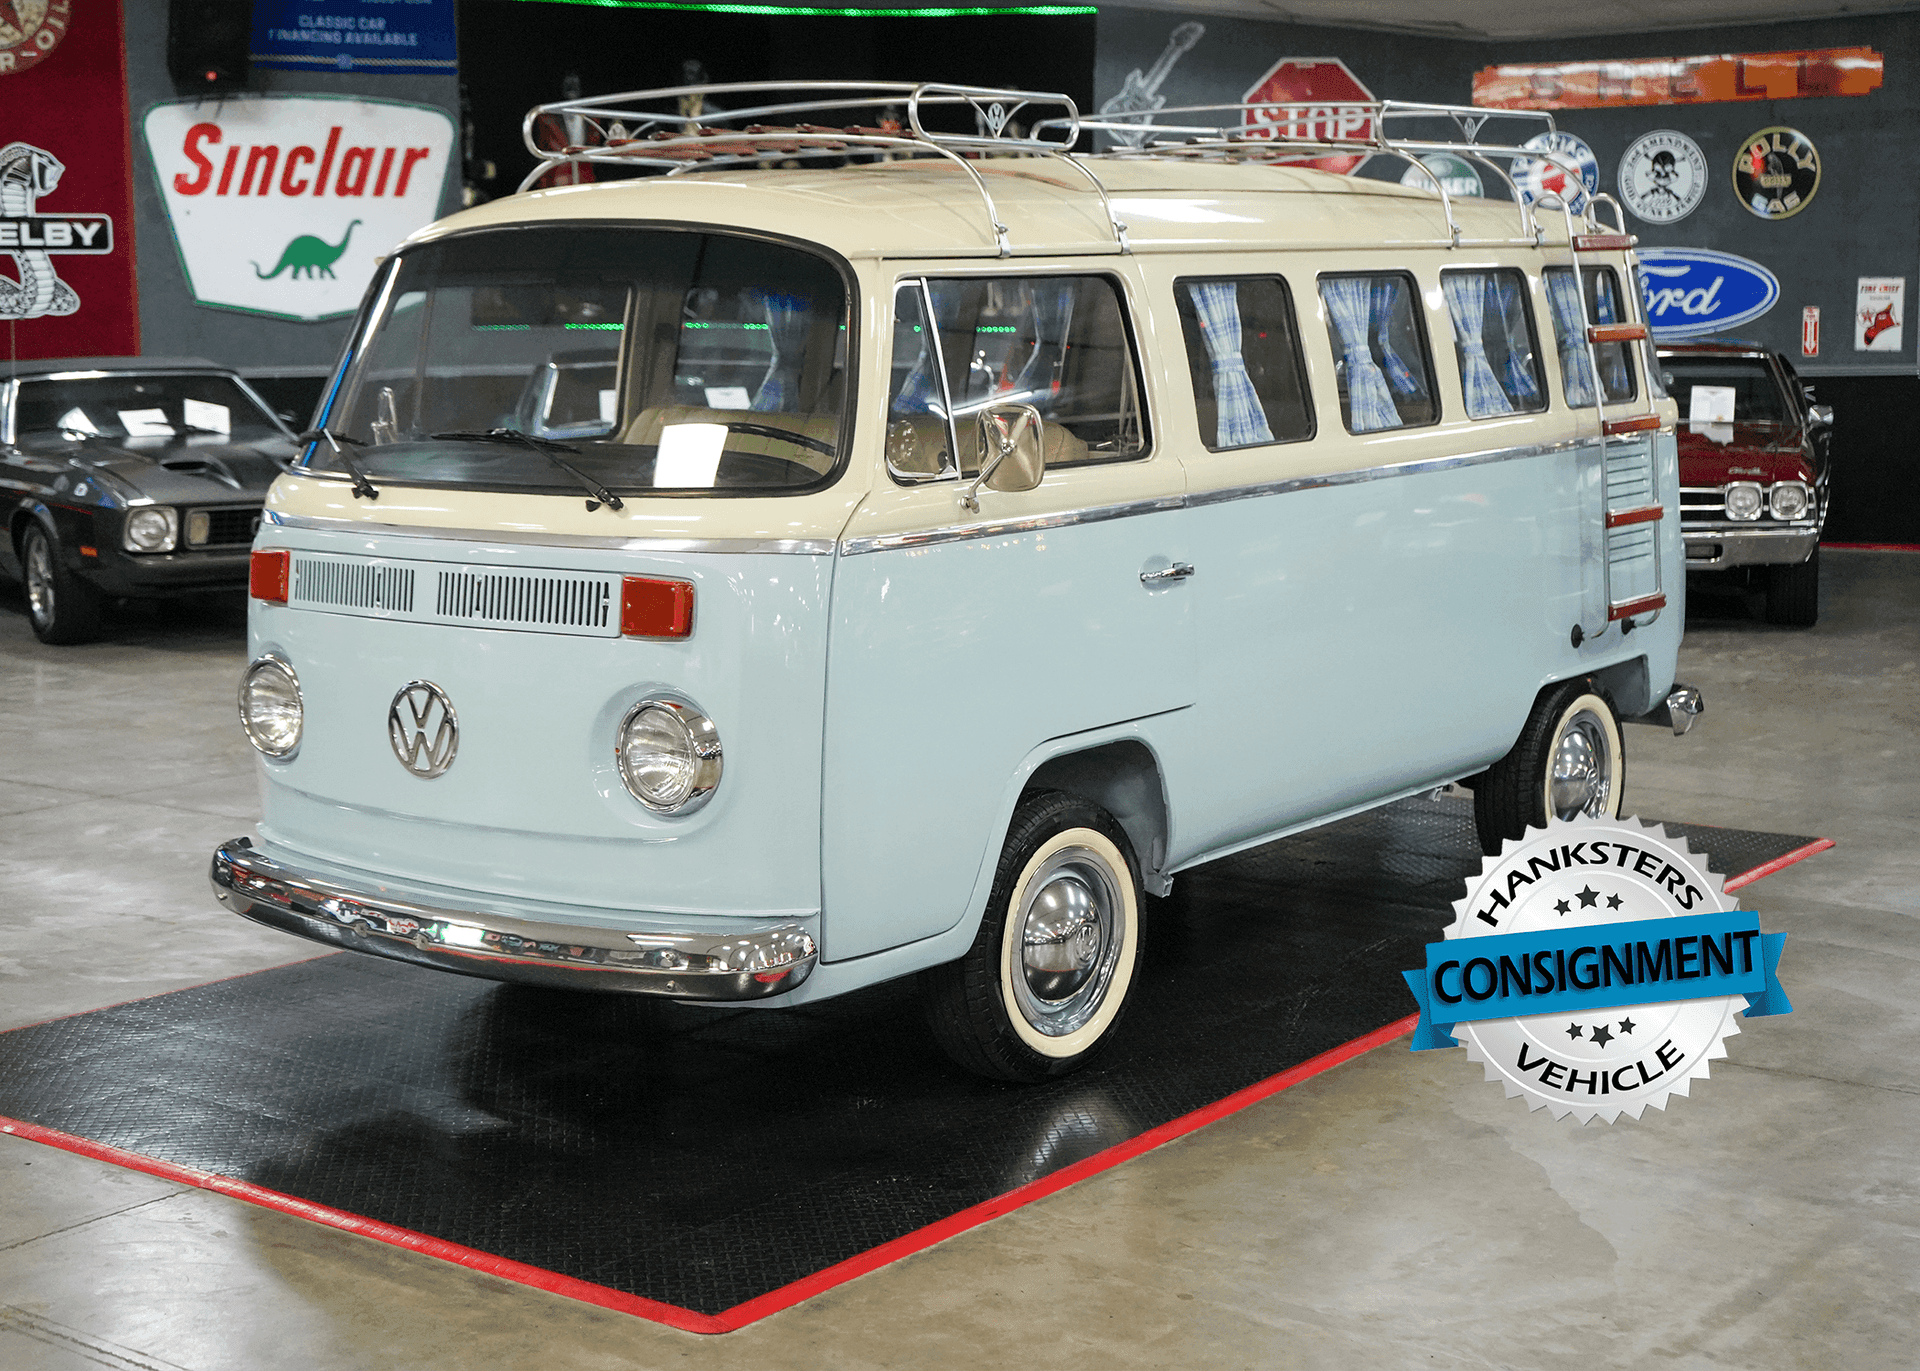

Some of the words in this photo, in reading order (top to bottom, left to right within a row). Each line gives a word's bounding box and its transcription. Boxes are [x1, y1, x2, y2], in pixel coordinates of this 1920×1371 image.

[268, 28, 342, 44] FINANCING
[344, 31, 418, 46] AVAILABLE
[298, 15, 356, 30] CLASSIC
[358, 17, 386, 30] CAR
[1254, 104, 1364, 141] STOP
[173, 121, 430, 198] Sinclair
[1738, 131, 1816, 174] POLLY
[389, 680, 459, 780] VW
